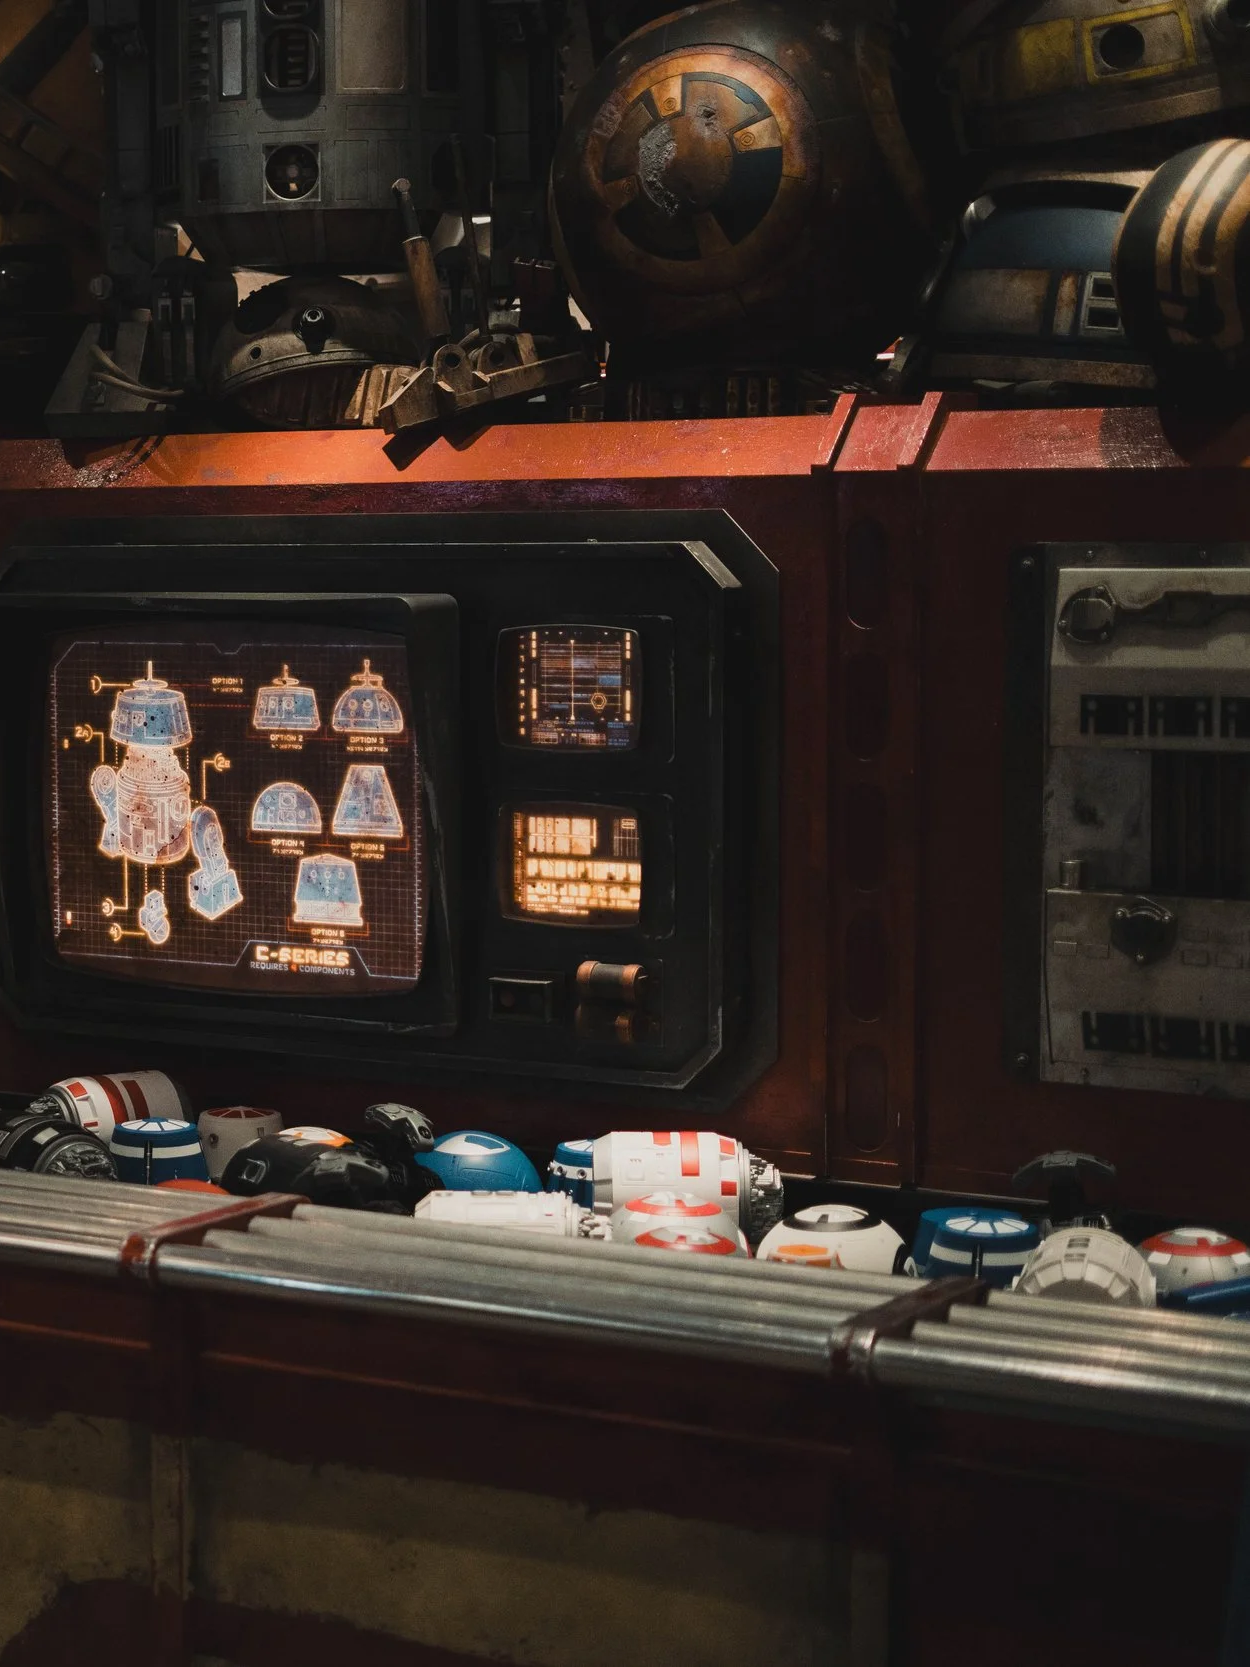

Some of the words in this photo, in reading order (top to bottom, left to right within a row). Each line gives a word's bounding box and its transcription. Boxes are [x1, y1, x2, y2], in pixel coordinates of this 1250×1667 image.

[270, 734, 297, 742] OPTION
[350, 736, 377, 744] OPTION
[271, 839, 297, 847] OPTION
[299, 840, 304, 848] 4
[350, 842, 377, 850] OPTION
[103, 902, 110, 912] 3
[311, 928, 338, 936] OPTION
[254, 945, 350, 966] C-SERIES
[250, 961, 289, 971] REQUIRES
[299, 965, 356, 976] COMPONENTS
